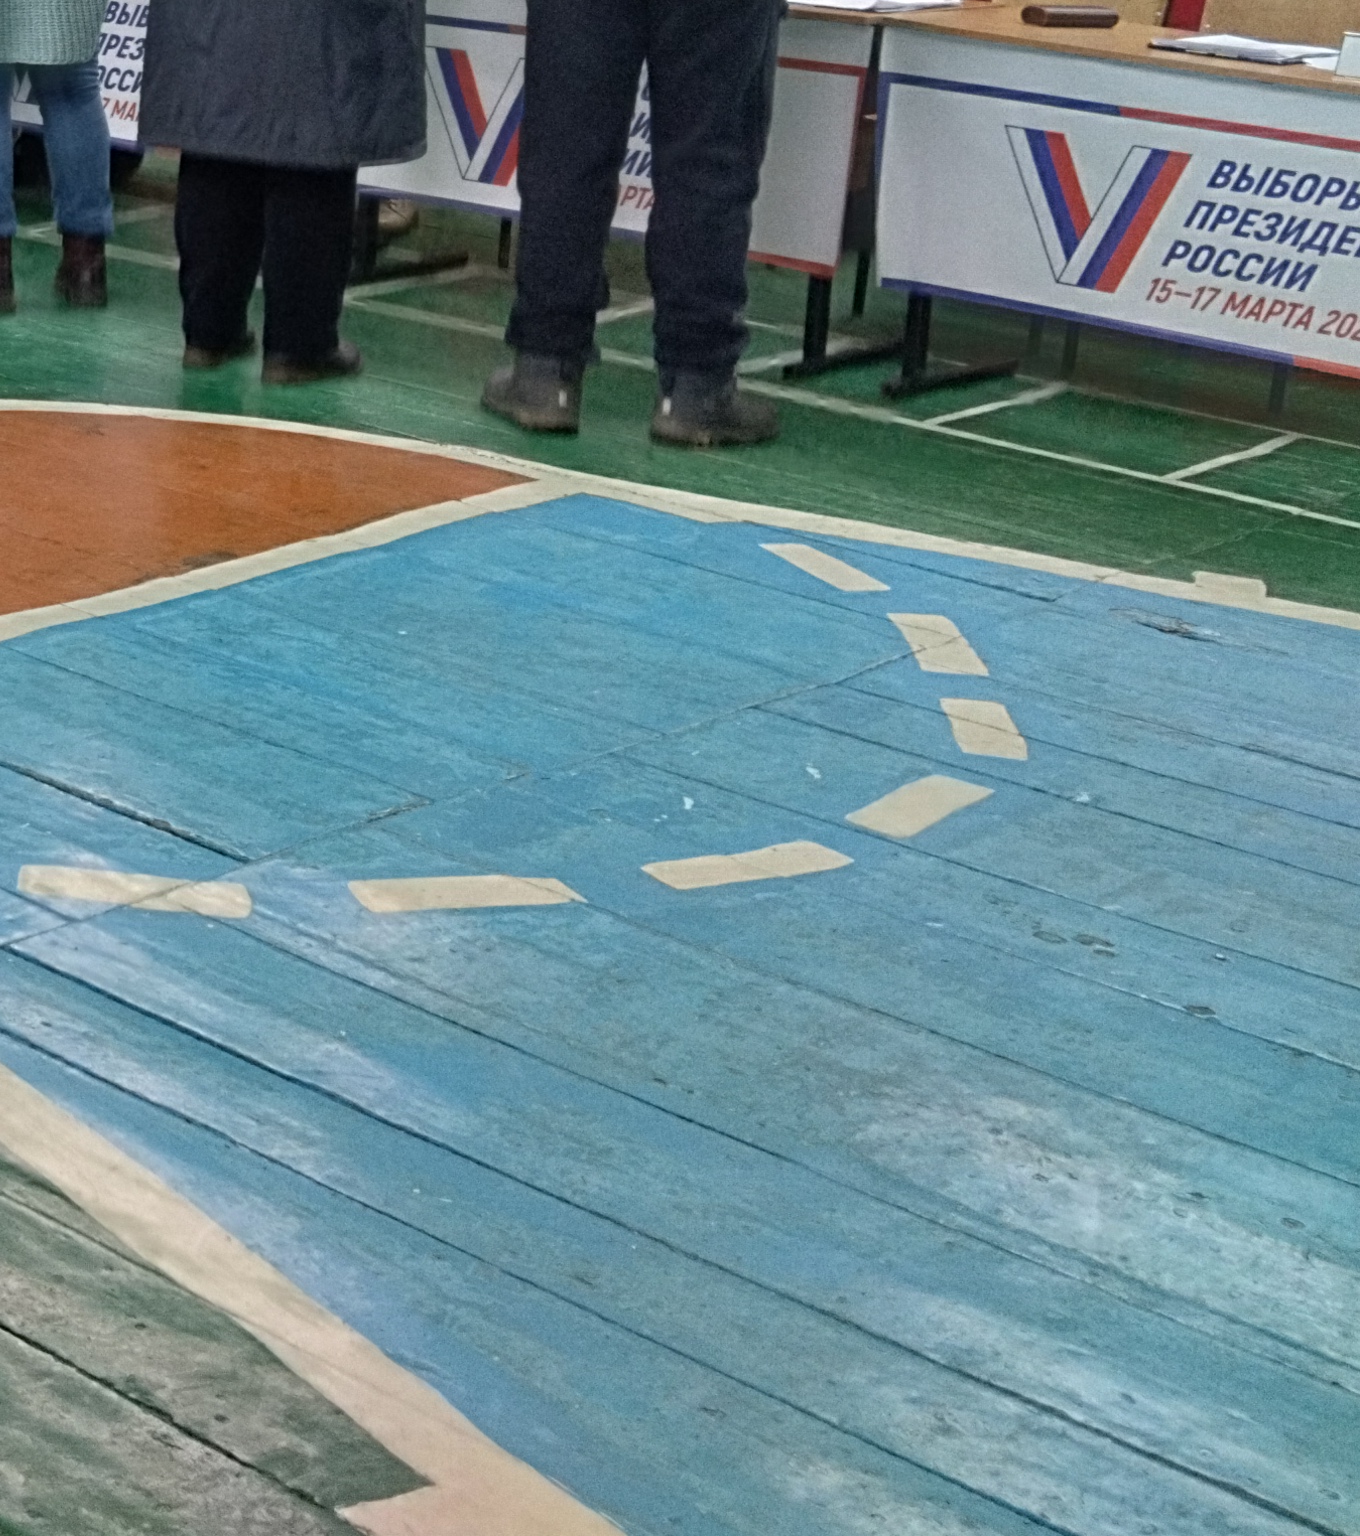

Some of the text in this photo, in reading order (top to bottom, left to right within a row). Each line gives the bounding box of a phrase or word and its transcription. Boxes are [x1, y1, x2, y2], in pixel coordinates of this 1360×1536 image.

[1183, 199, 1360, 258] ПРЕЗИДЕ
[1161, 239, 1319, 292] РОССИИ
[1220, 291, 1316, 331] МАРТА
[1317, 310, 1360, 341] 20
